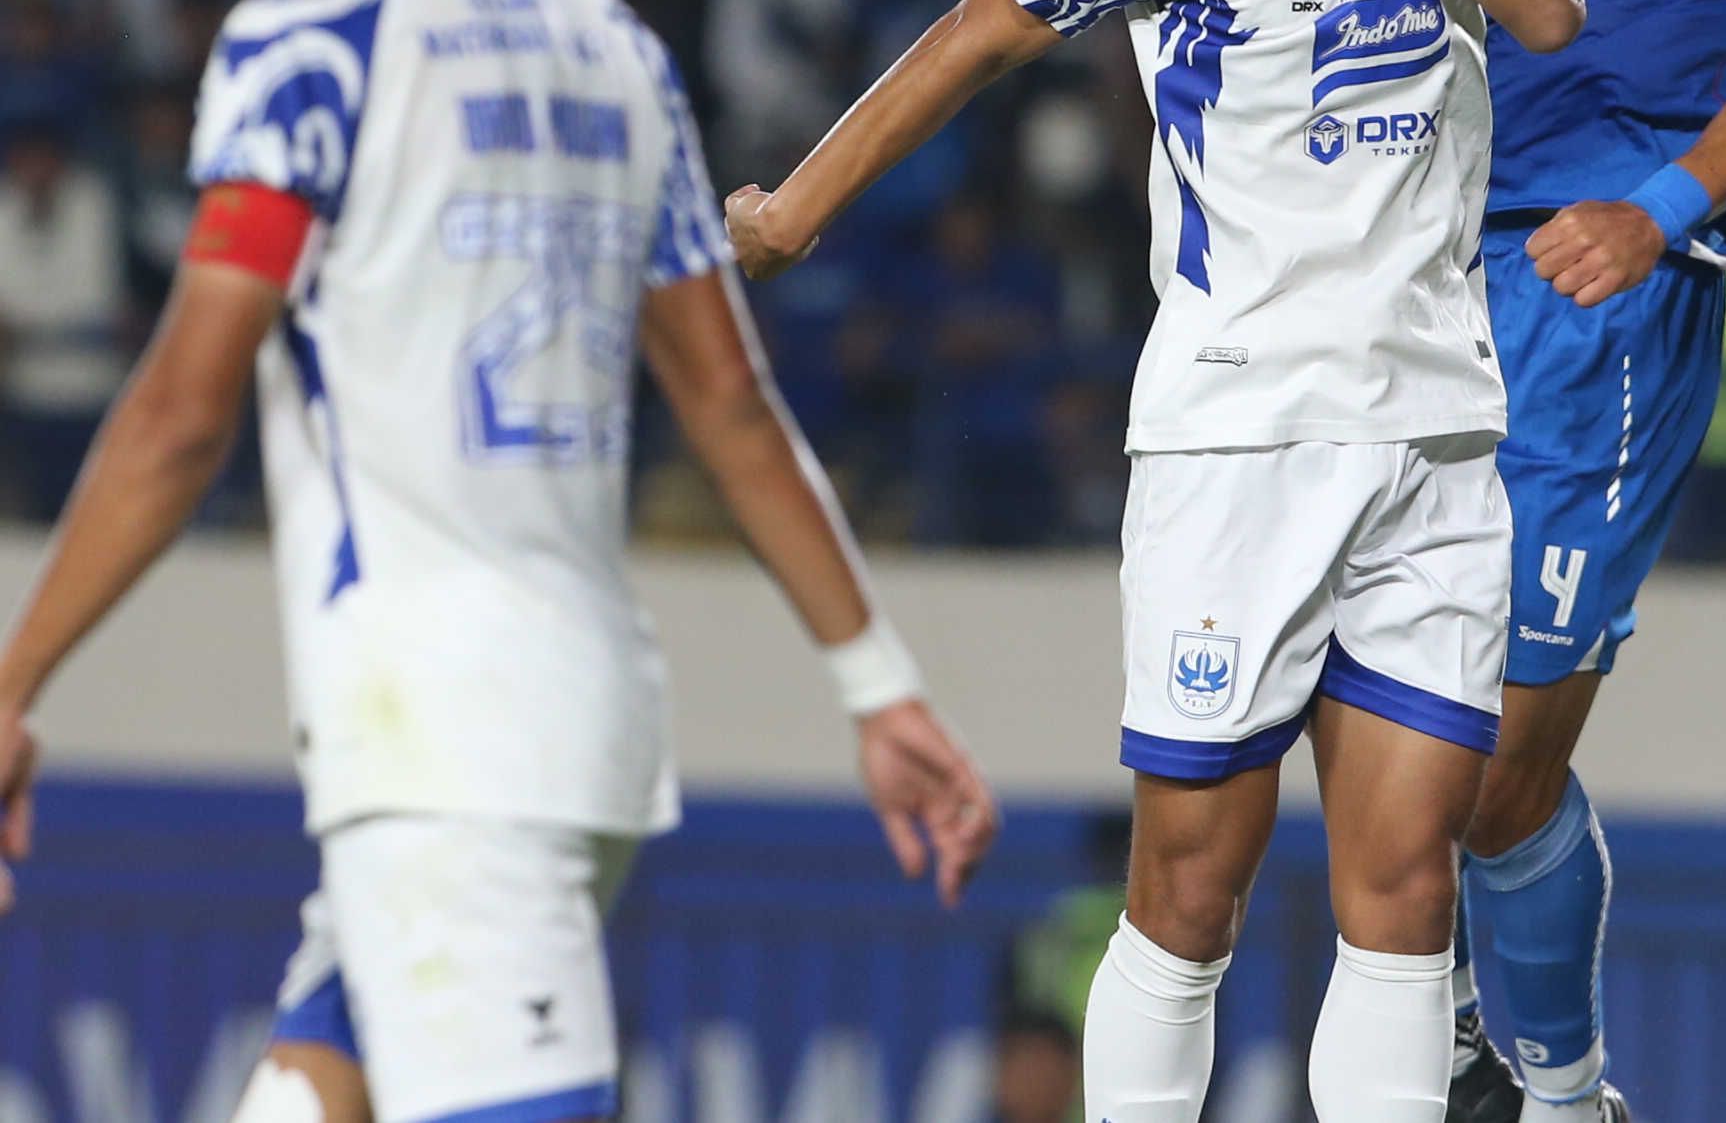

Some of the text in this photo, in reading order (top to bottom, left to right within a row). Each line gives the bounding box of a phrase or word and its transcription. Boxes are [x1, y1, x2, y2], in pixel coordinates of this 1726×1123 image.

[1292, 1, 1324, 13] DRX
[1357, 109, 1441, 143] DRX
[1373, 143, 1431, 157] TOKEN
[1540, 545, 1588, 628] 4
[1518, 624, 1575, 647] Sportama
